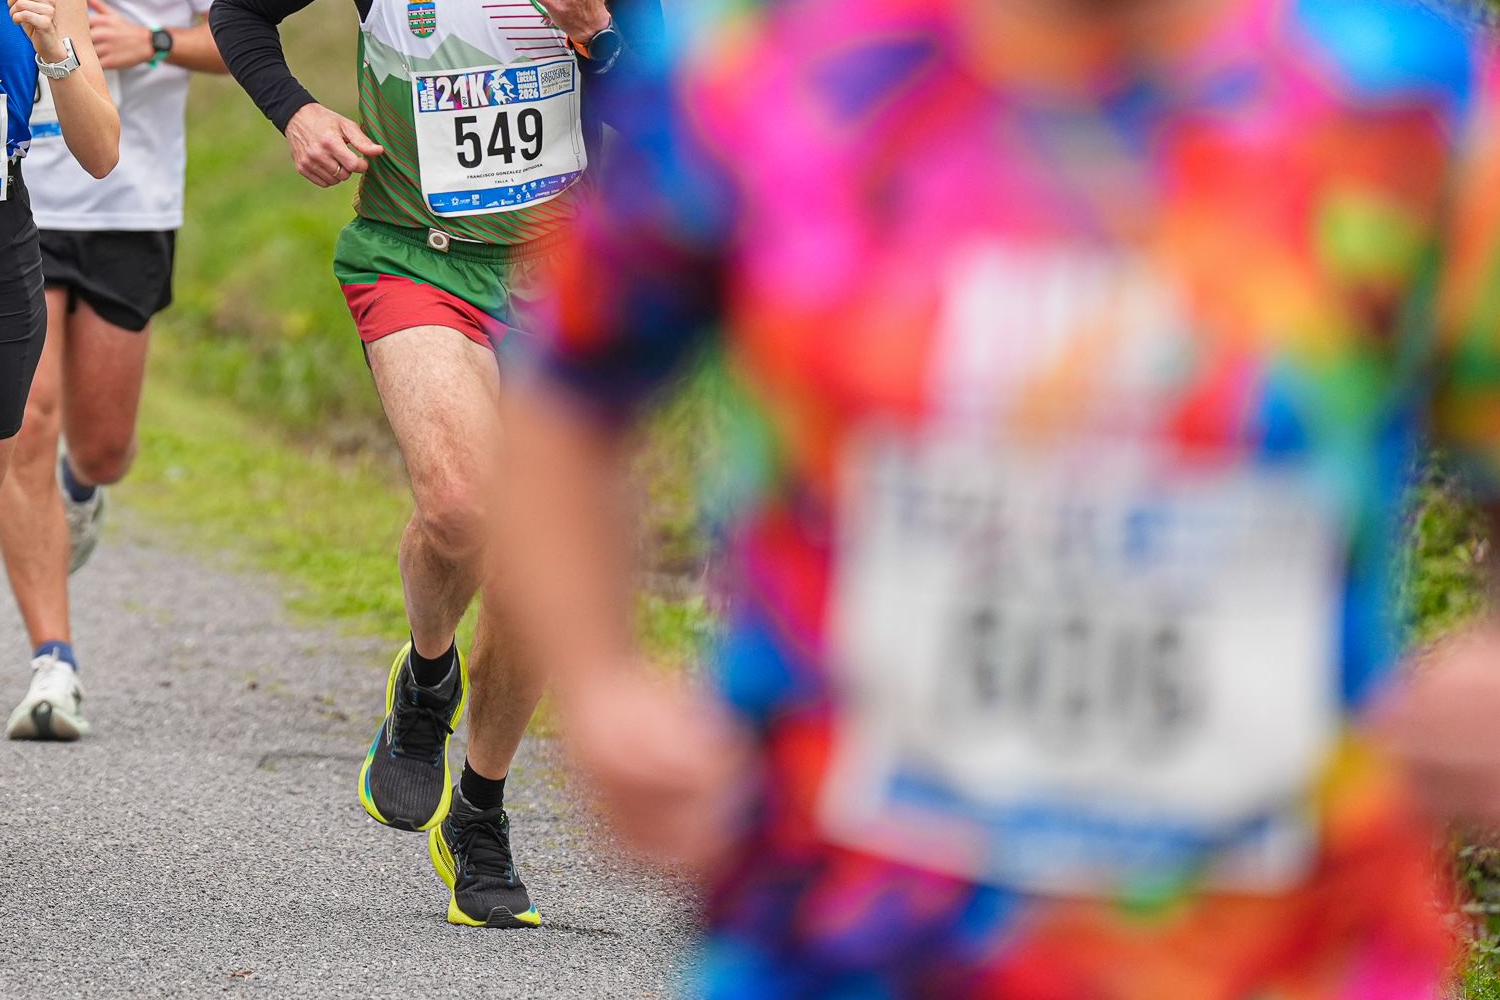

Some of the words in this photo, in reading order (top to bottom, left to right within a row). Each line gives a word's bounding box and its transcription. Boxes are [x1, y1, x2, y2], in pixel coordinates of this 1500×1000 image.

[436, 73, 489, 110] 21K
[519, 88, 540, 99] 2026
[454, 107, 543, 168] 549
